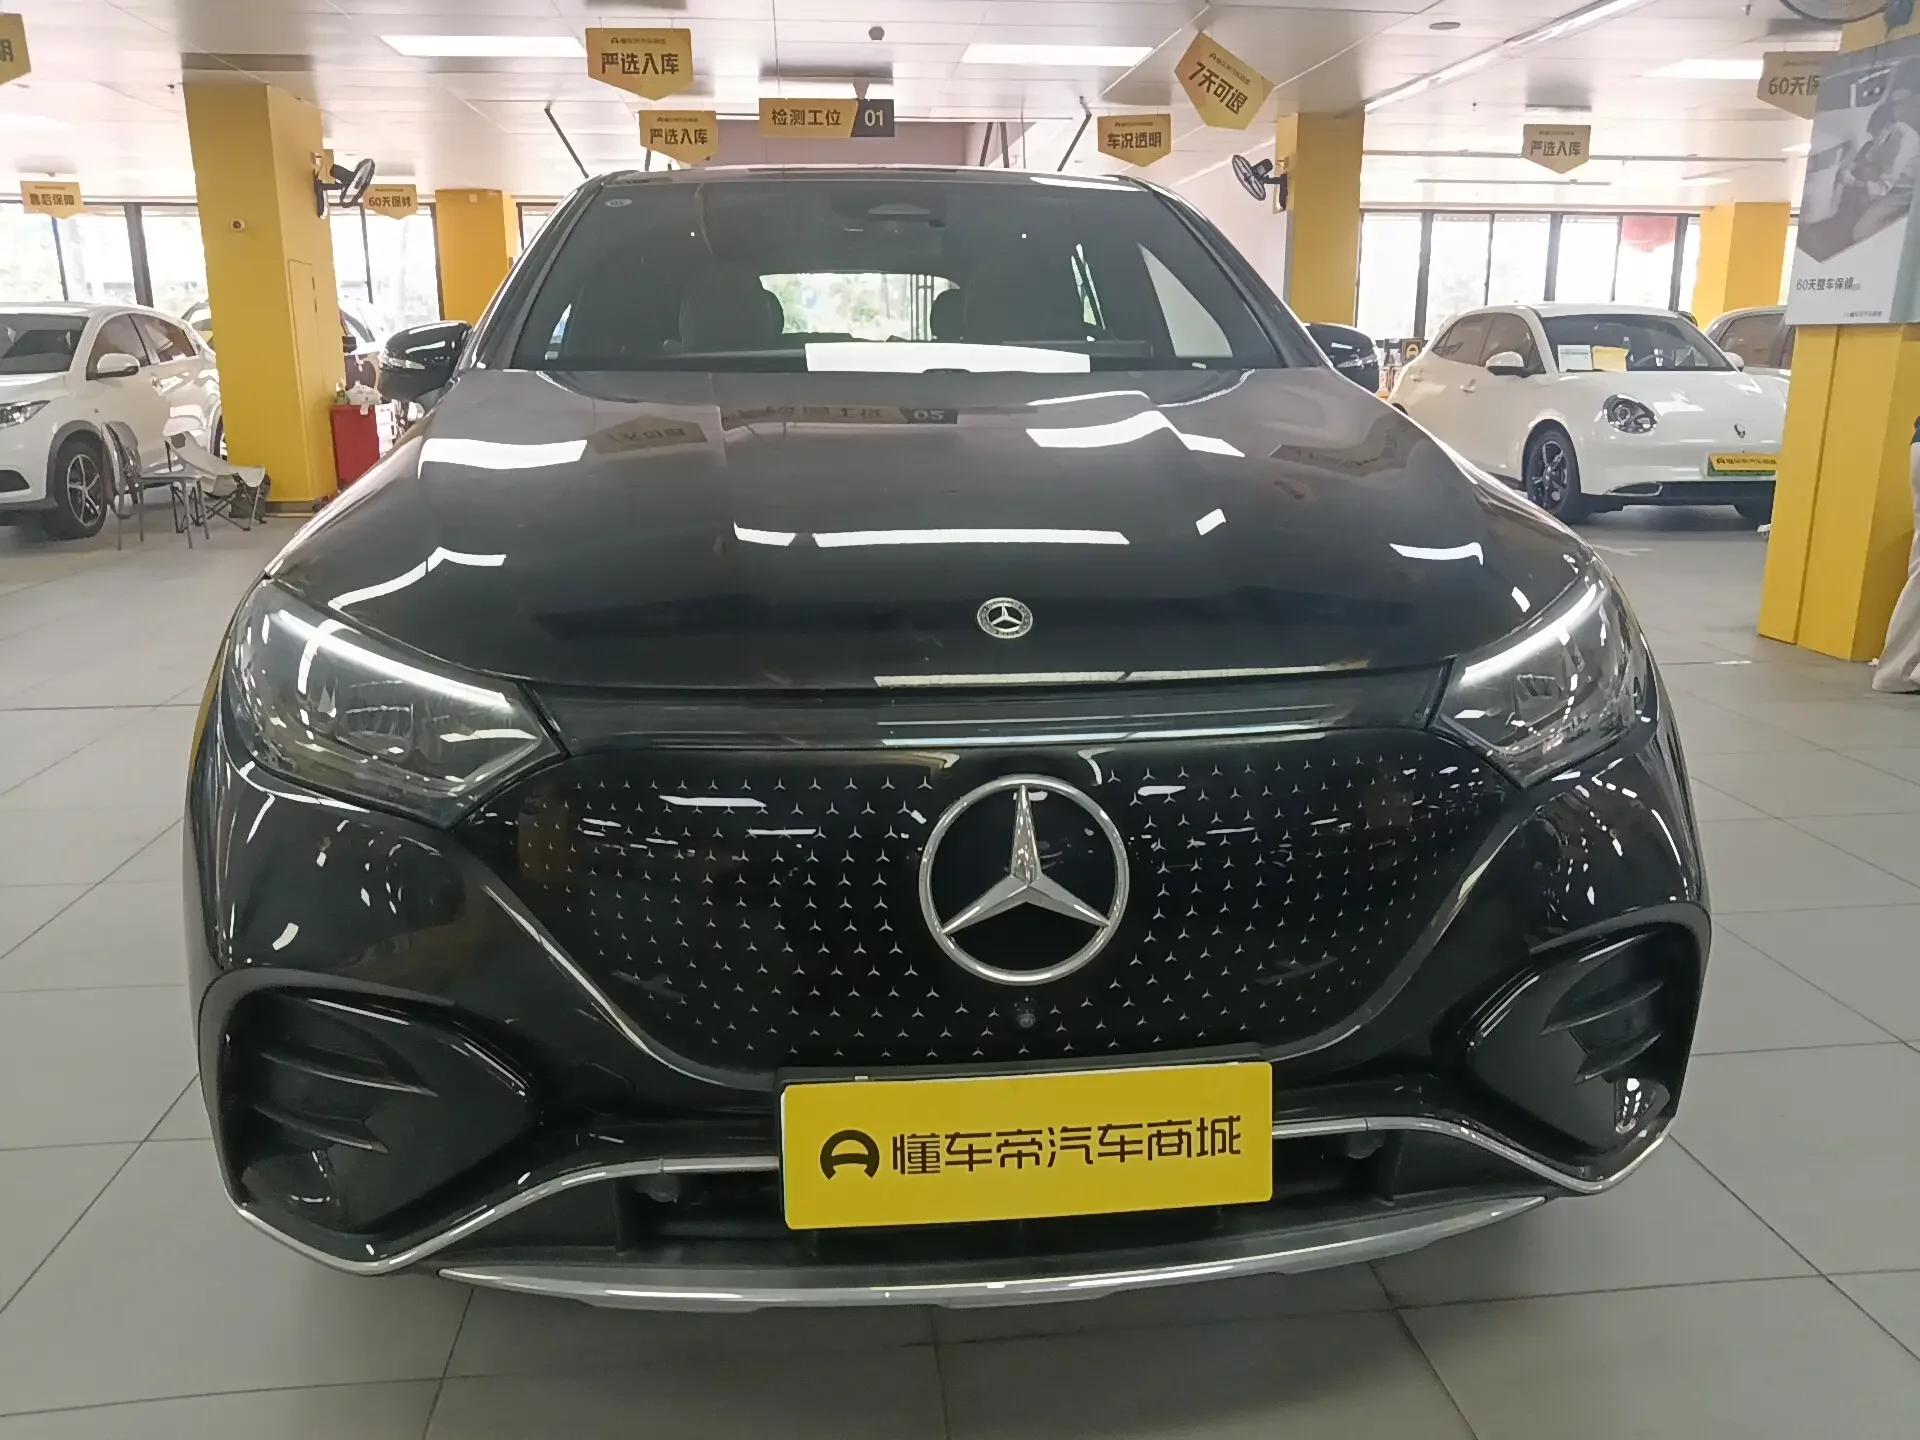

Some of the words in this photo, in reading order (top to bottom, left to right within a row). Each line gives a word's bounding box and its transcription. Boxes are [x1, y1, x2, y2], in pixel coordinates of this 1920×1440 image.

[601, 53, 680, 75] 严选入库
[1188, 60, 1249, 115] 7天可退
[771, 108, 842, 126] 检测工位
[864, 109, 884, 127] 01
[649, 128, 709, 145] 严选入库
[1106, 131, 1162, 150] 车况透明
[1530, 141, 1582, 157] 严选入库
[368, 195, 411, 208] 60天保修
[891, 1115, 1242, 1175] 懂车帝汽车商城
